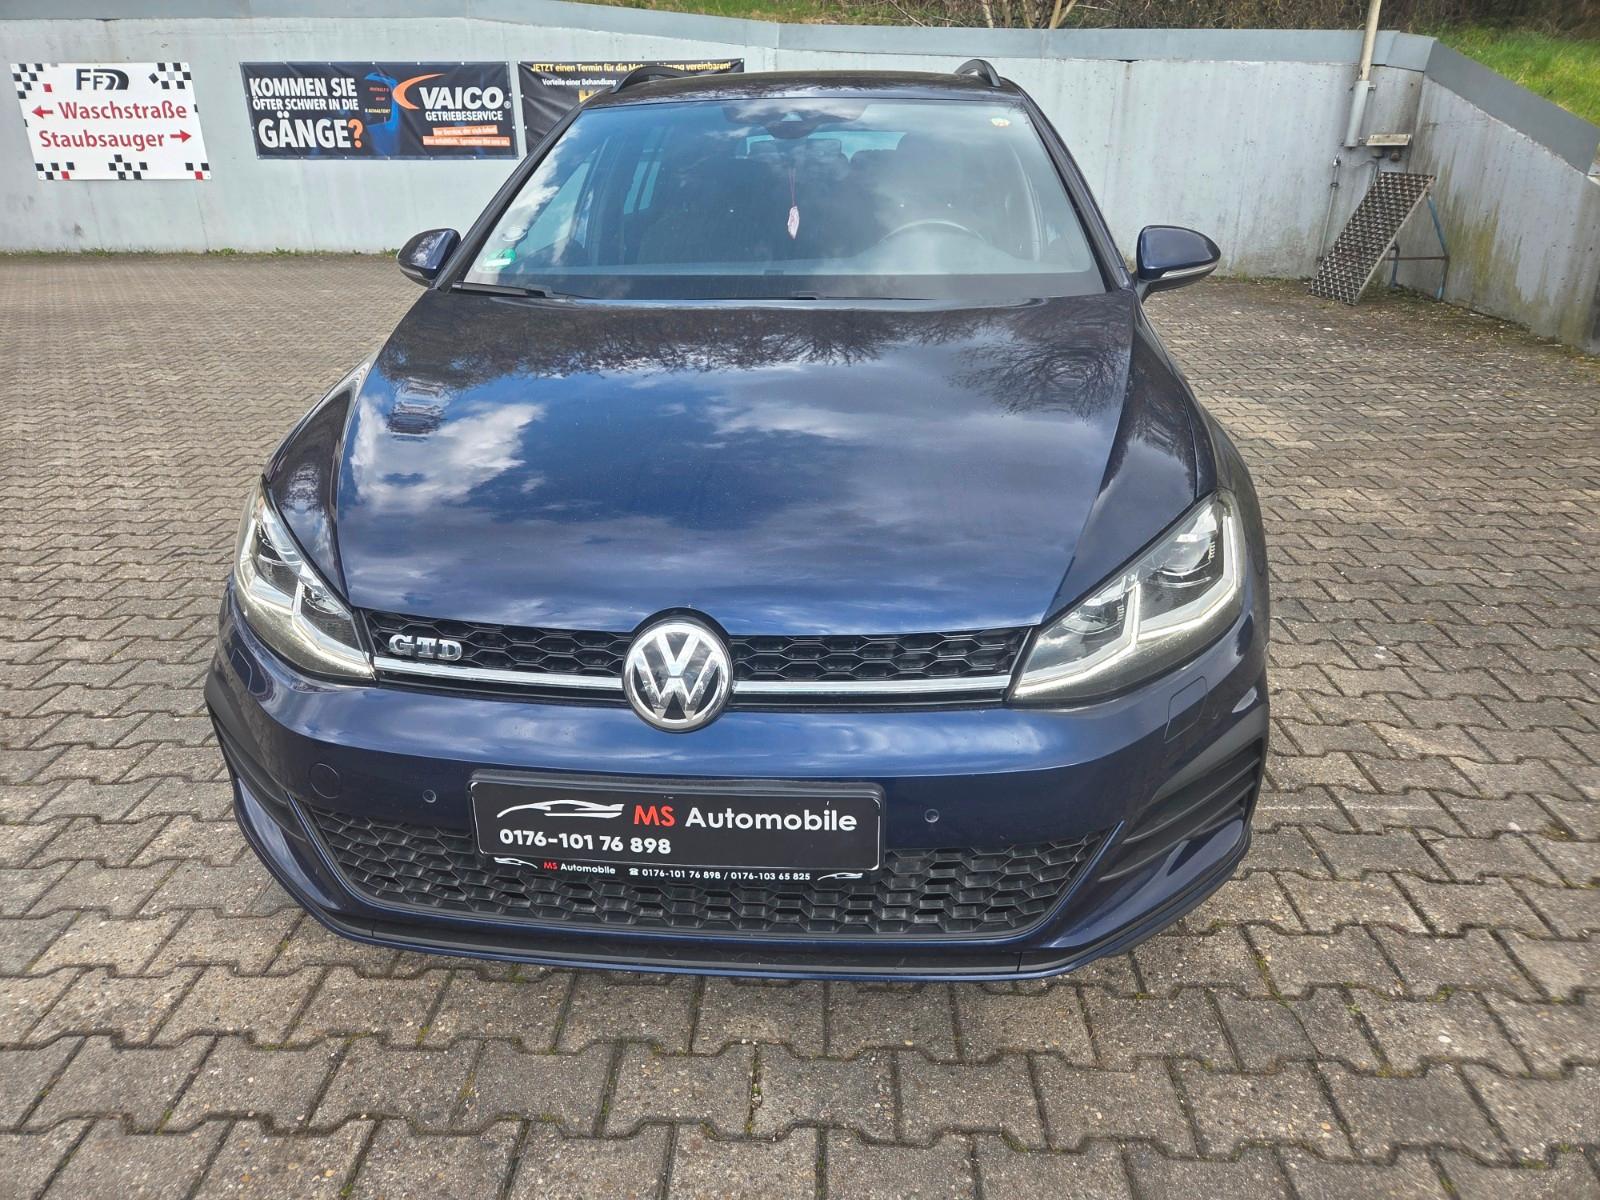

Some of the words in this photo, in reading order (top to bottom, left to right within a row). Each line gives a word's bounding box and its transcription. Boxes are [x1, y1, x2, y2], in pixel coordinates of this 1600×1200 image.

[531, 63, 554, 72] JETZT
[555, 63, 576, 72] einen
[577, 63, 603, 72] Termin
[604, 63, 615, 72] für
[616, 63, 628, 72] die
[249, 78, 328, 97] KOMMEN
[332, 78, 358, 97] SIE
[582, 78, 617, 87] Behandlung
[252, 97, 283, 111] ÖFTER
[285, 99, 326, 111] SCHWER
[329, 99, 340, 110] IN
[342, 99, 359, 110] DIE
[419, 86, 504, 110] VAICO
[58, 101, 187, 120] Waschstraße
[425, 110, 504, 122] GETRIEBESERVICE
[258, 111, 364, 149] GÄNGE?
[39, 129, 165, 151] Staubsauger
[388, 634, 463, 661] GTD
[633, 804, 676, 828] MS
[685, 807, 858, 832] Automobile
[500, 829, 594, 850] 0176-101
[599, 836, 624, 852] 76
[630, 838, 672, 855] 898
[543, 862, 558, 871] MS
[560, 863, 617, 876] Automobile
[642, 868, 686, 879] 0176-101
[689, 870, 701, 879] 76
[703, 870, 721, 880] 898
[730, 871, 775, 881] 0176-103
[778, 872, 790, 881] 65
[793, 872, 811, 881] 825
